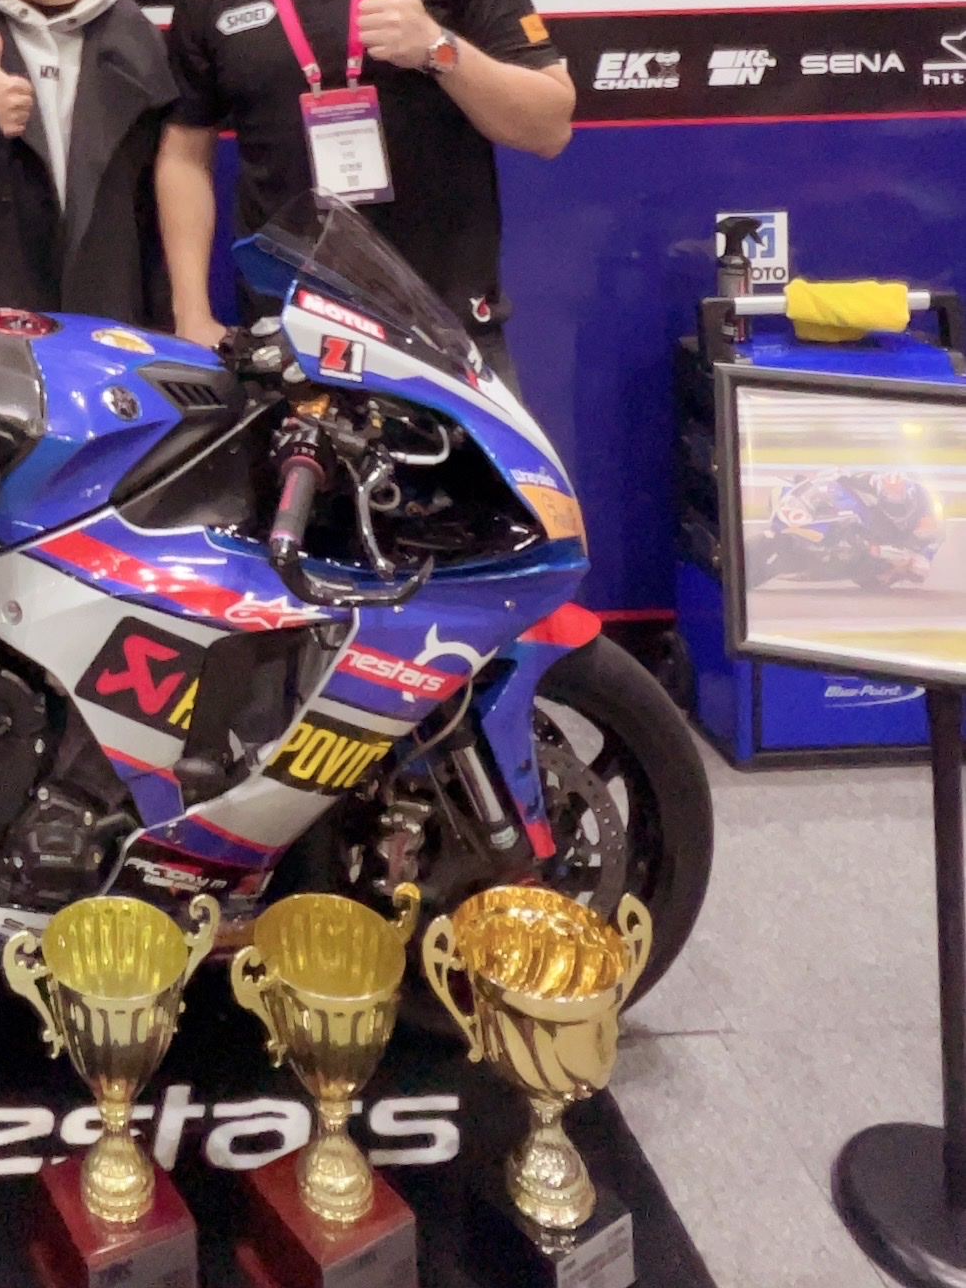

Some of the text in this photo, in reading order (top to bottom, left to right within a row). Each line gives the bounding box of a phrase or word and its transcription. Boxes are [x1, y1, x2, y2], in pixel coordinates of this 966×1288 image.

[226, 7, 267, 29] SHOEI
[595, 52, 657, 79] EK
[800, 53, 906, 75] SENA
[592, 77, 680, 91] CHAINS
[299, 290, 386, 340] MOTUL
